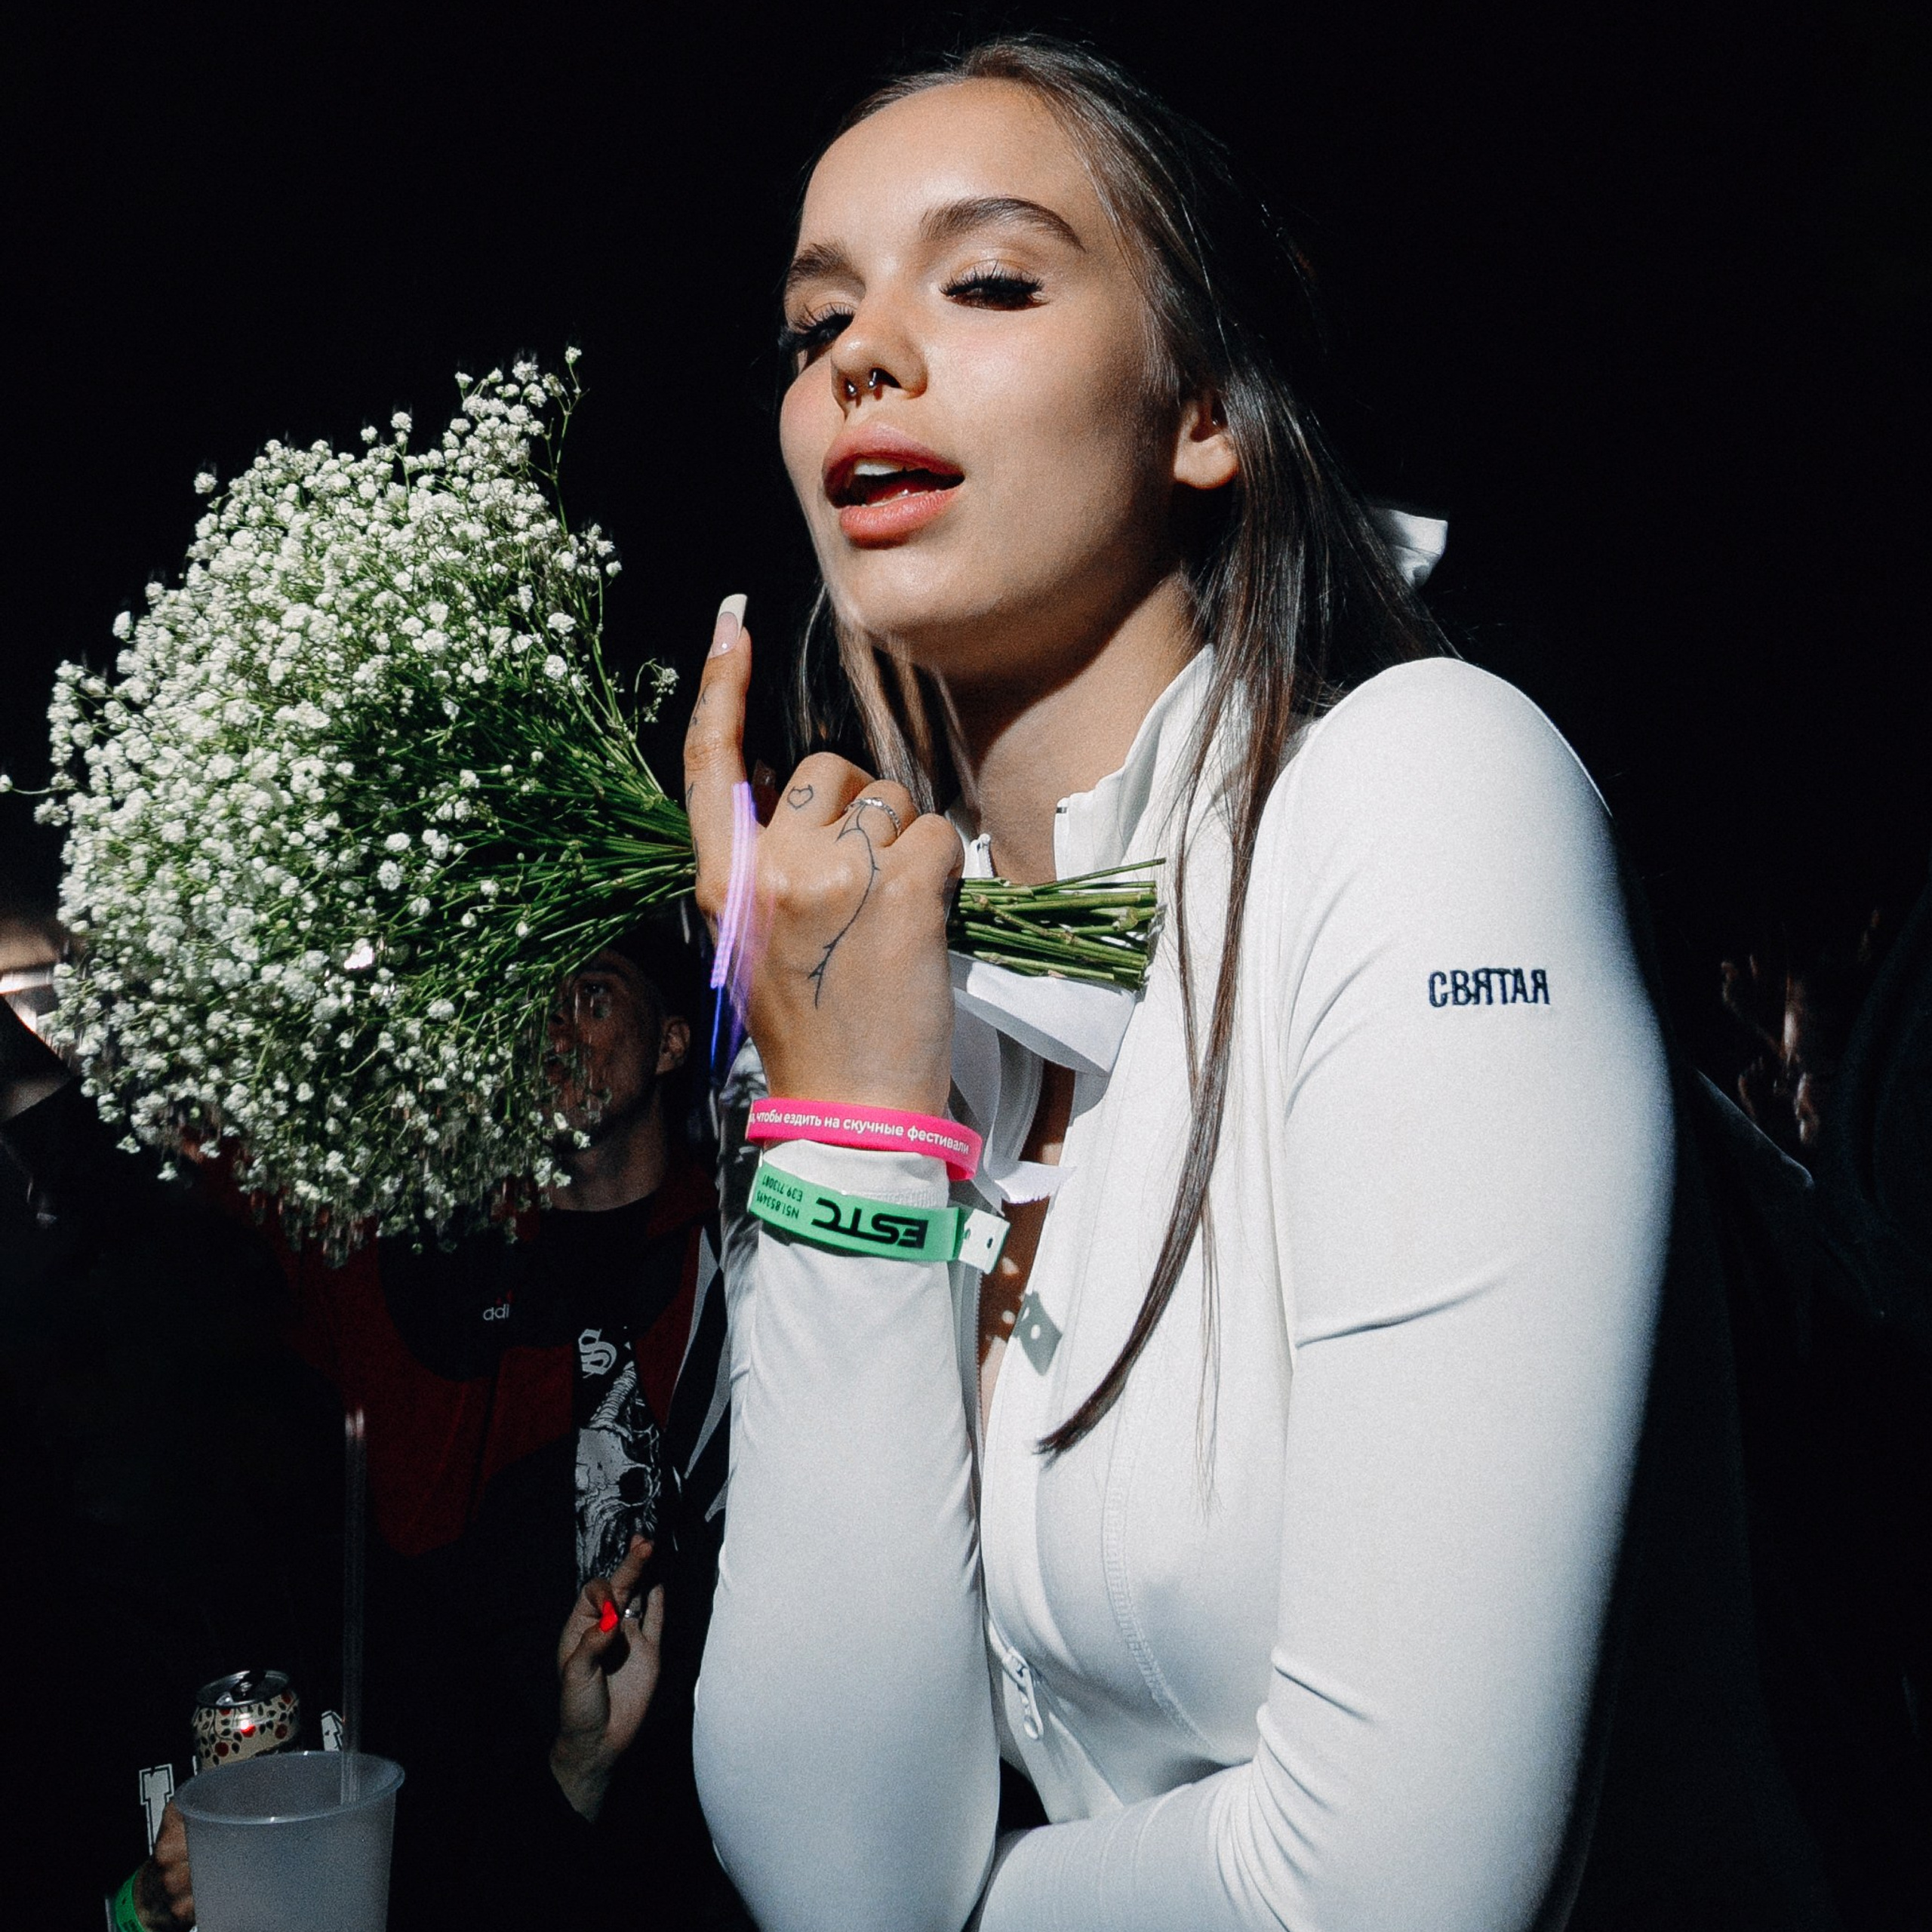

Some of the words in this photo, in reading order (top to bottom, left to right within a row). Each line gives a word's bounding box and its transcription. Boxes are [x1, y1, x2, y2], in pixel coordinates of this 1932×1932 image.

[1428, 968, 1550, 1008] СВЯТАЯ
[756, 1109, 782, 1123] чтобы
[783, 1113, 821, 1127] ездить
[824, 1117, 840, 1128] на
[842, 1118, 904, 1137] скучные
[907, 1124, 970, 1155] фестивали
[811, 1197, 929, 1248] ESTC
